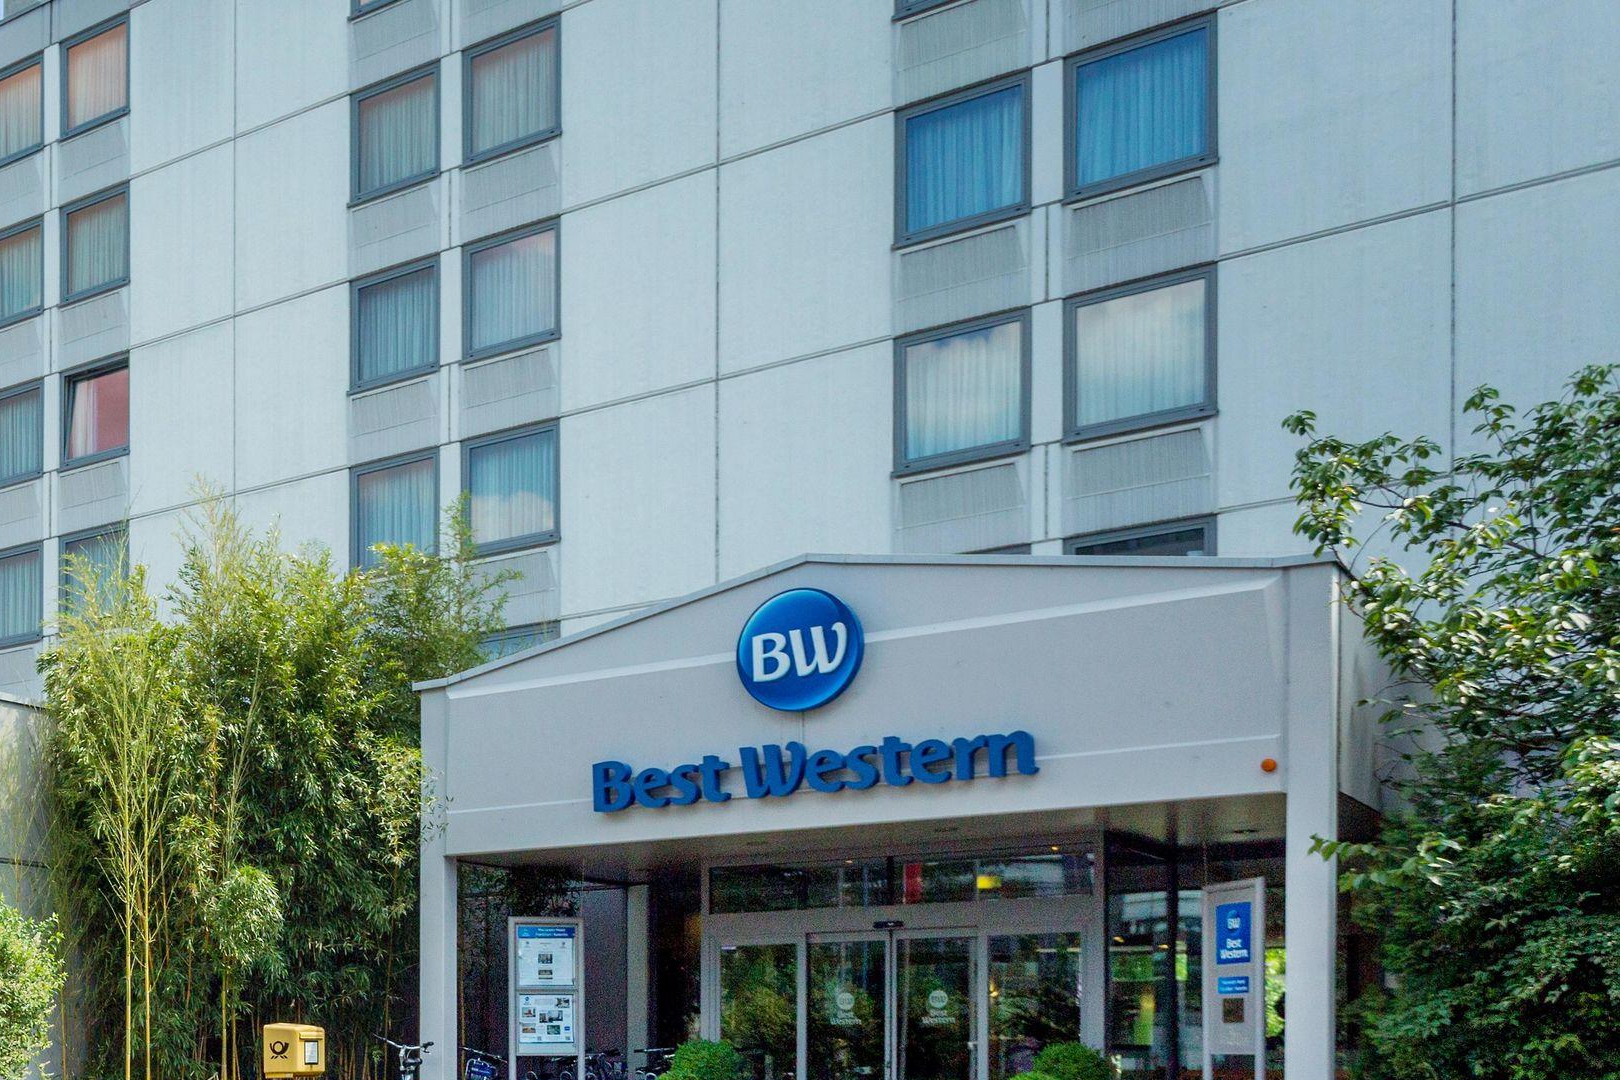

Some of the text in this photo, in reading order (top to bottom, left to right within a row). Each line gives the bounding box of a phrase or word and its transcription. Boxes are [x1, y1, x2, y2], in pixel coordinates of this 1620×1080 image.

[752, 622, 847, 683] BW
[592, 729, 1040, 813] Best Western
[1220, 949, 1249, 959] Western
[1226, 938, 1242, 949] Best
